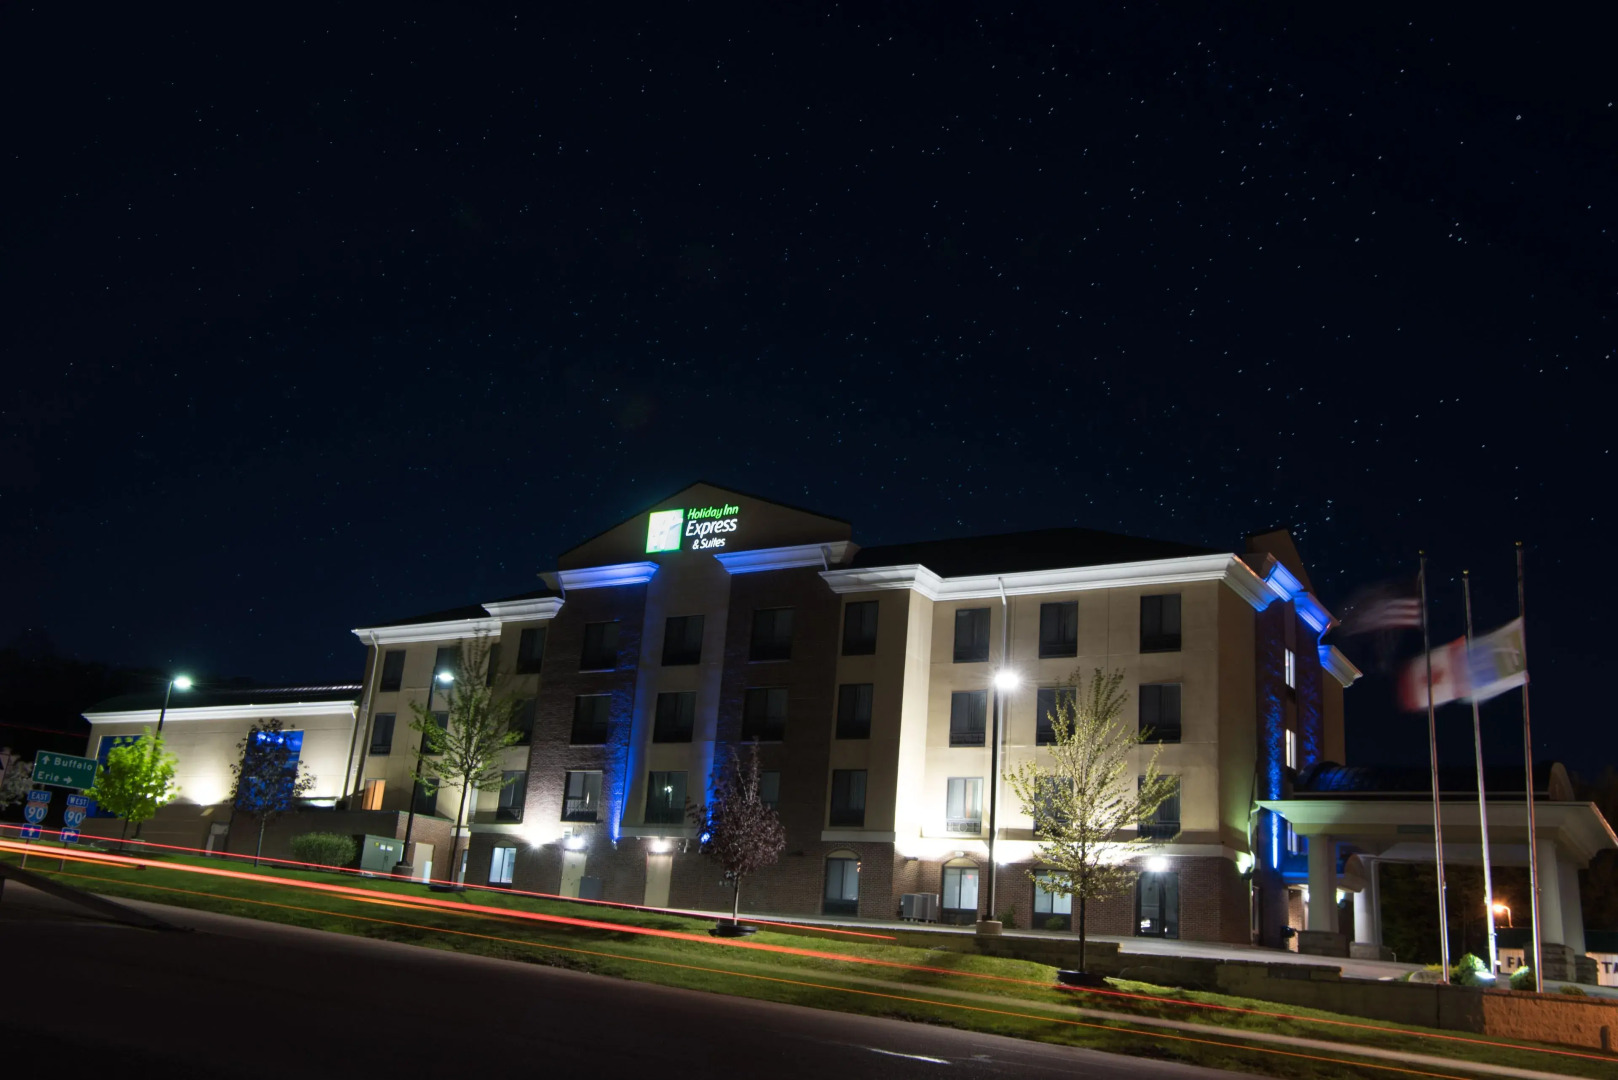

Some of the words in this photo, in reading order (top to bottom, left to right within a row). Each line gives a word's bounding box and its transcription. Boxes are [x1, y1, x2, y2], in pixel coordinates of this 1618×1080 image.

[687, 506, 723, 520] Holiday
[723, 503, 739, 516] Inn
[685, 518, 738, 539] Express
[692, 539, 699, 550] &
[700, 537, 726, 549] Suites
[54, 757, 93, 771] Buffalo
[37, 771, 60, 782] Erie
[31, 791, 48, 801] EAST
[70, 796, 87, 806] WEST
[28, 807, 44, 820] 90
[68, 811, 83, 824] 90
